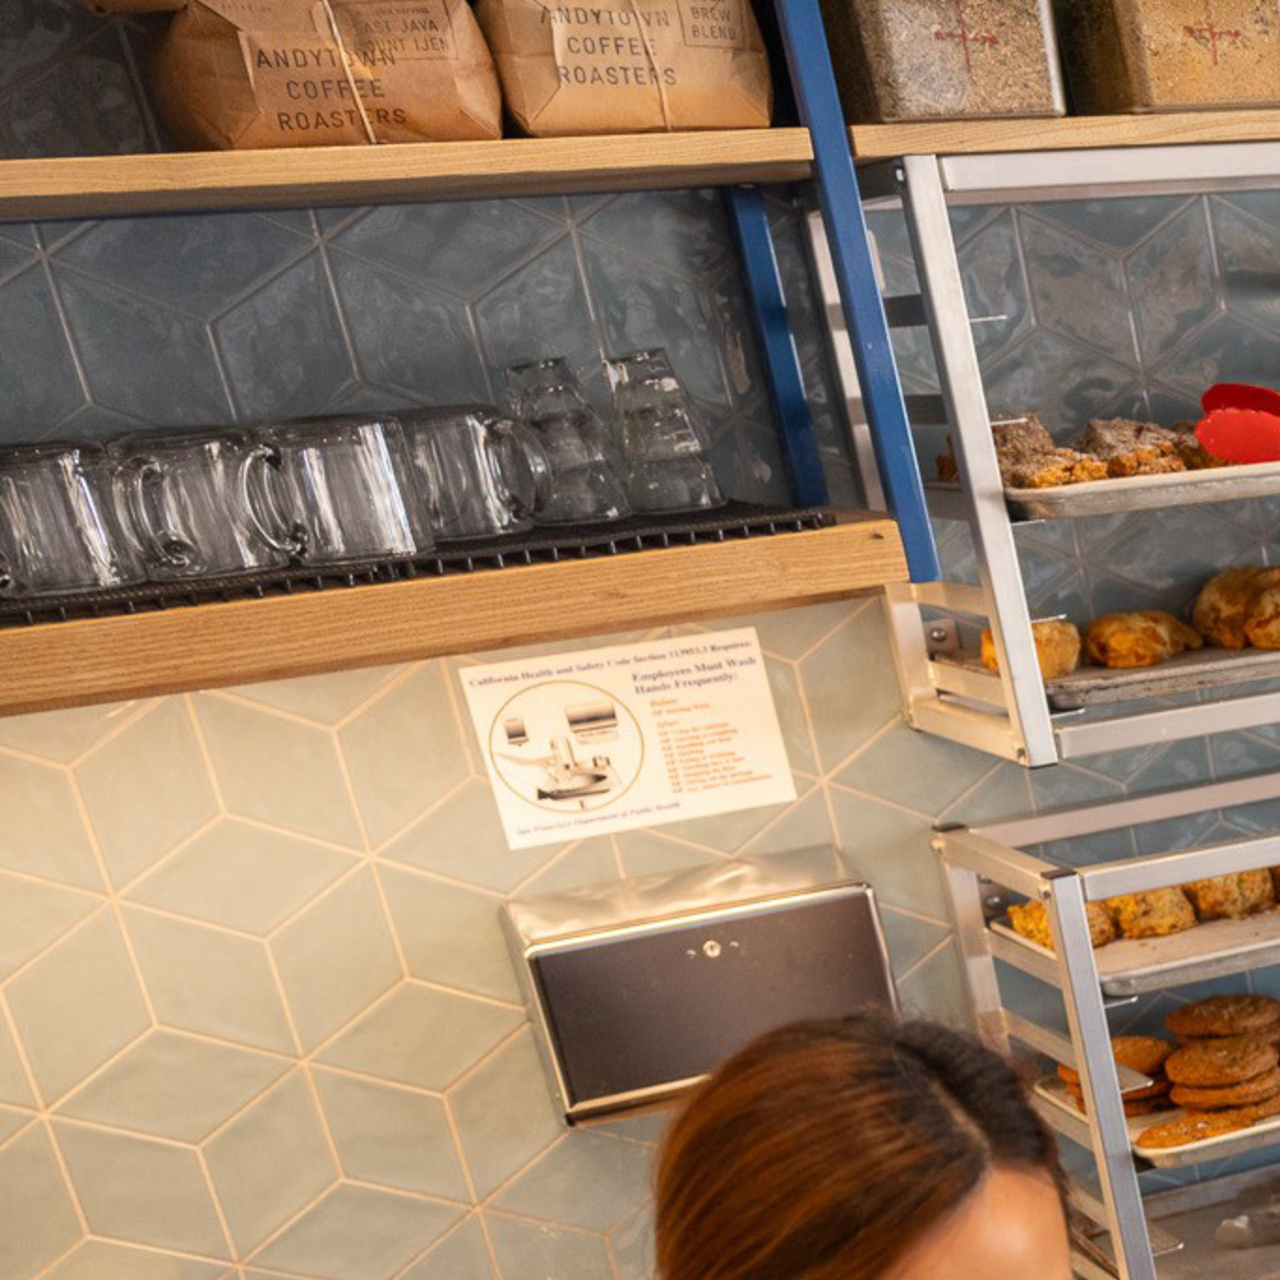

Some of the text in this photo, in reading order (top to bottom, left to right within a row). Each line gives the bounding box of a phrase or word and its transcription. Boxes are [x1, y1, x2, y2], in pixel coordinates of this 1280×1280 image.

[691, 7, 730, 21] BREW
[362, 19, 439, 33] AST JAVA
[692, 24, 736, 40] BLEND
[363, 36, 451, 52] OUNT IJEN
[567, 36, 657, 55] COFFEE
[557, 66, 677, 85] ROASTERS
[286, 78, 386, 100] COFFEE
[277, 108, 407, 131] ROASTERS
[632, 657, 756, 683] Employees Must Wash
[635, 683, 671, 695] Hands
